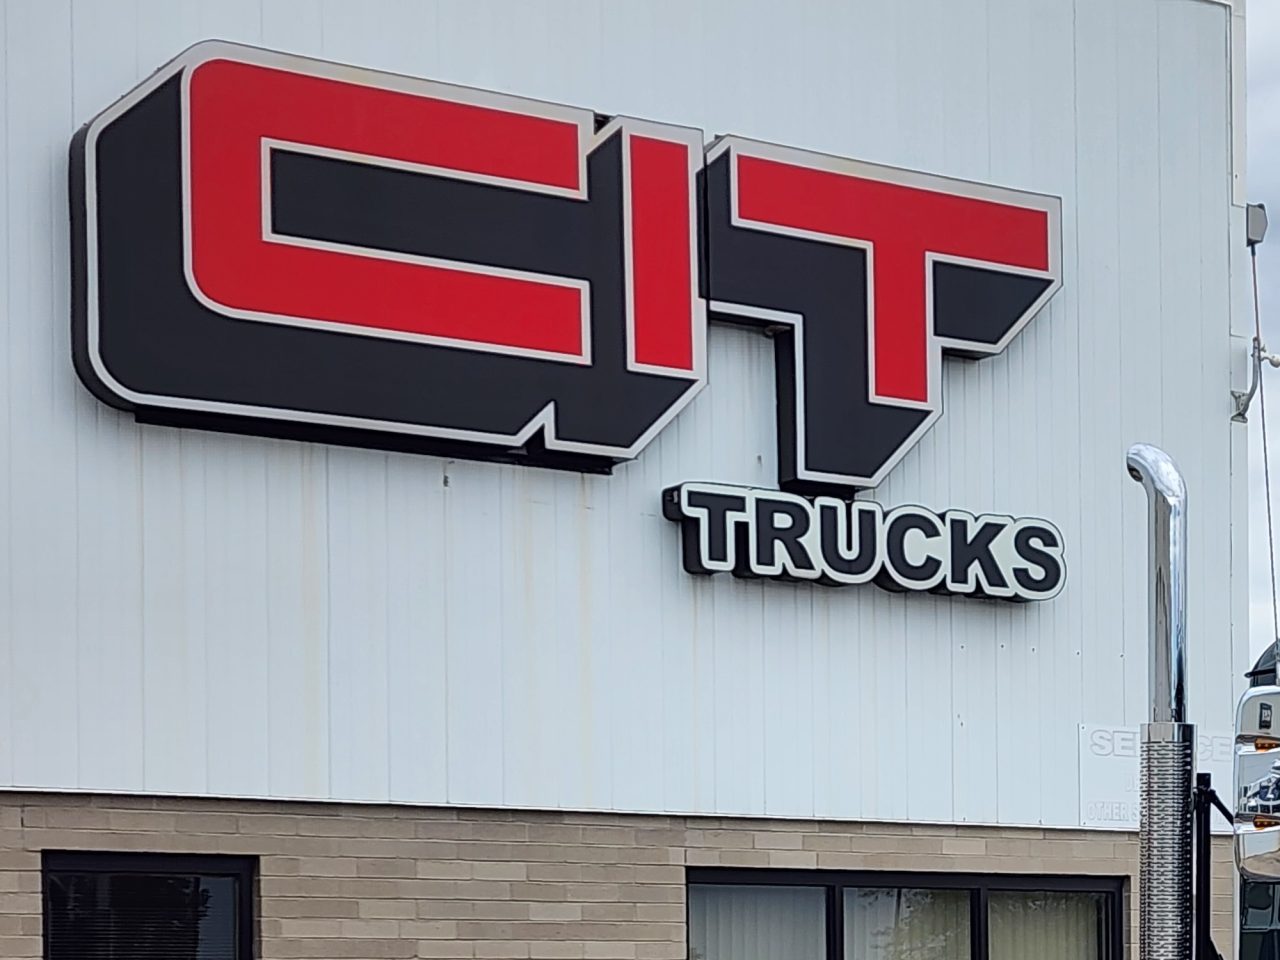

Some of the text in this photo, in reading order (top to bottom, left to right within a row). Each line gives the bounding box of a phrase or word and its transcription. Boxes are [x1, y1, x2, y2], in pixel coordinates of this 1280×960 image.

[180, 52, 1056, 408] CIT
[686, 489, 1063, 593] TRUCKS
[1090, 728, 1232, 763] SECE
